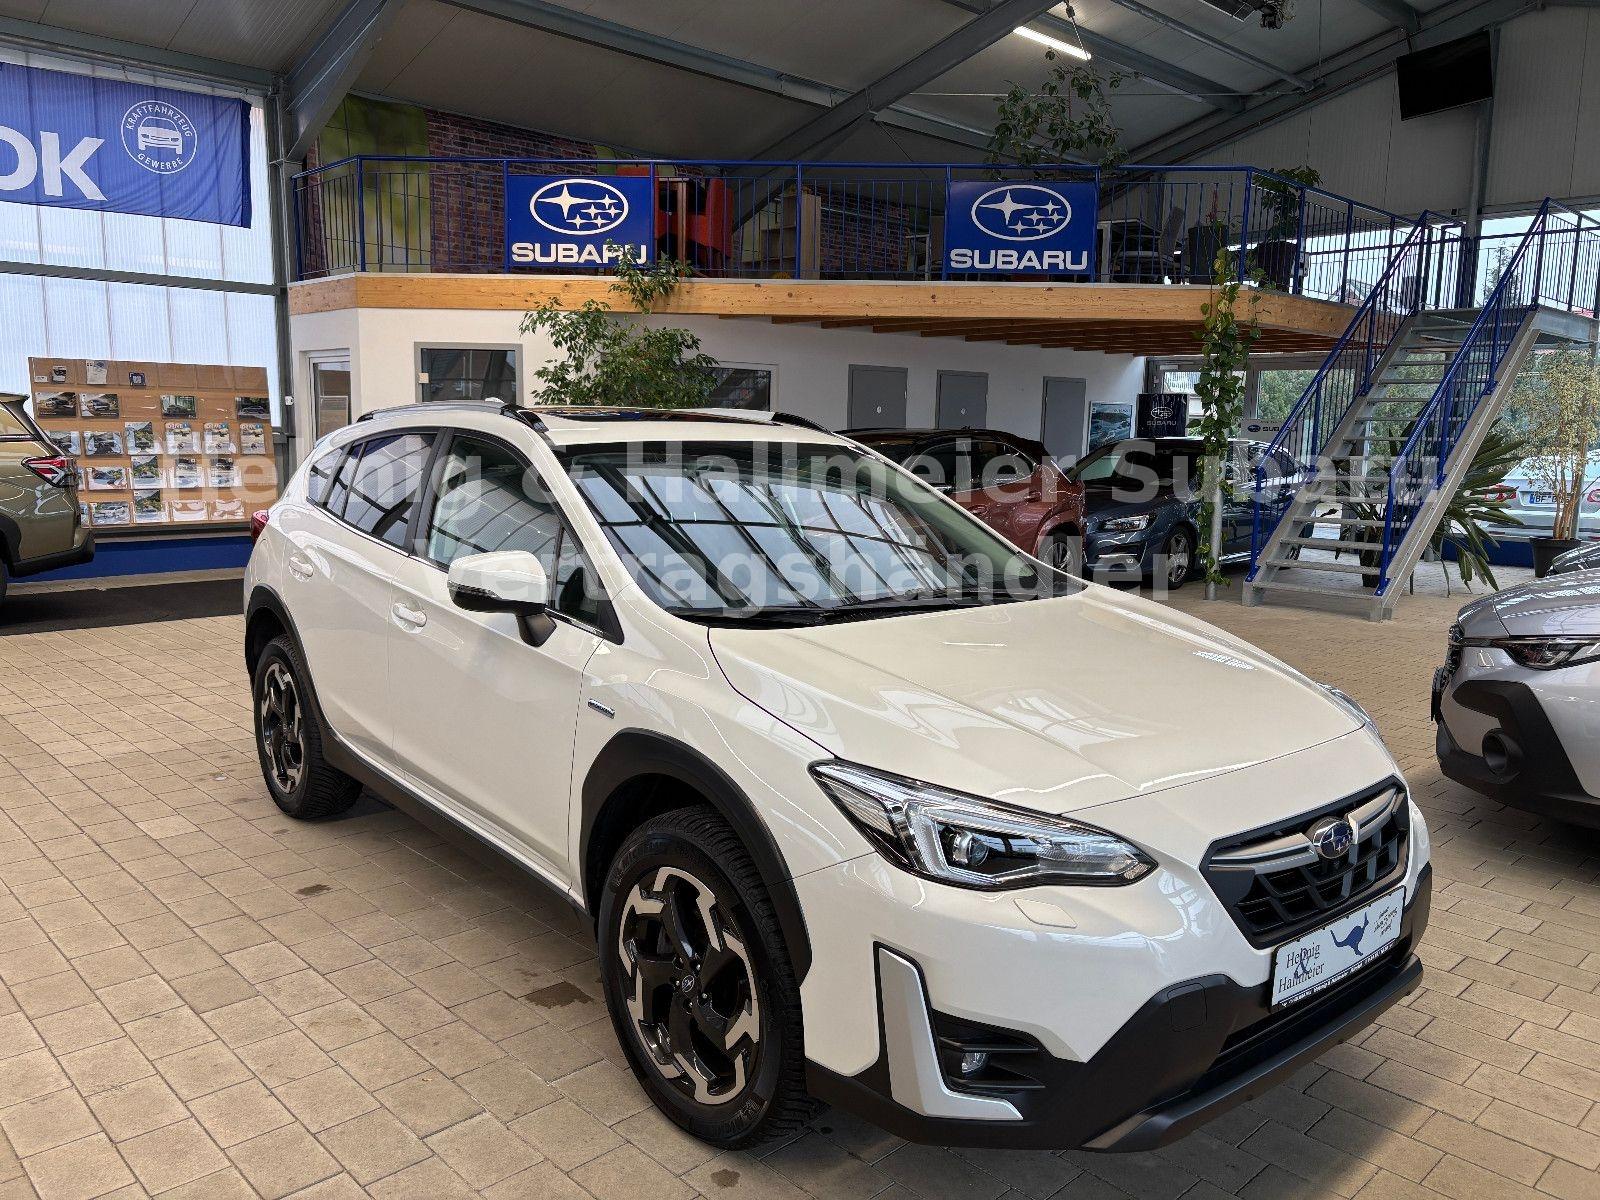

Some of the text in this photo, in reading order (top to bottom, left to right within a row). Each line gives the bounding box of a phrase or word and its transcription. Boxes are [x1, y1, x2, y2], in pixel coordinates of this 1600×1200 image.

[126, 104, 193, 138] KRAFTFAHRZEUG
[137, 152, 184, 171] GEWERBE
[511, 242, 647, 264] SUBARU
[950, 248, 1088, 271] SUBARU
